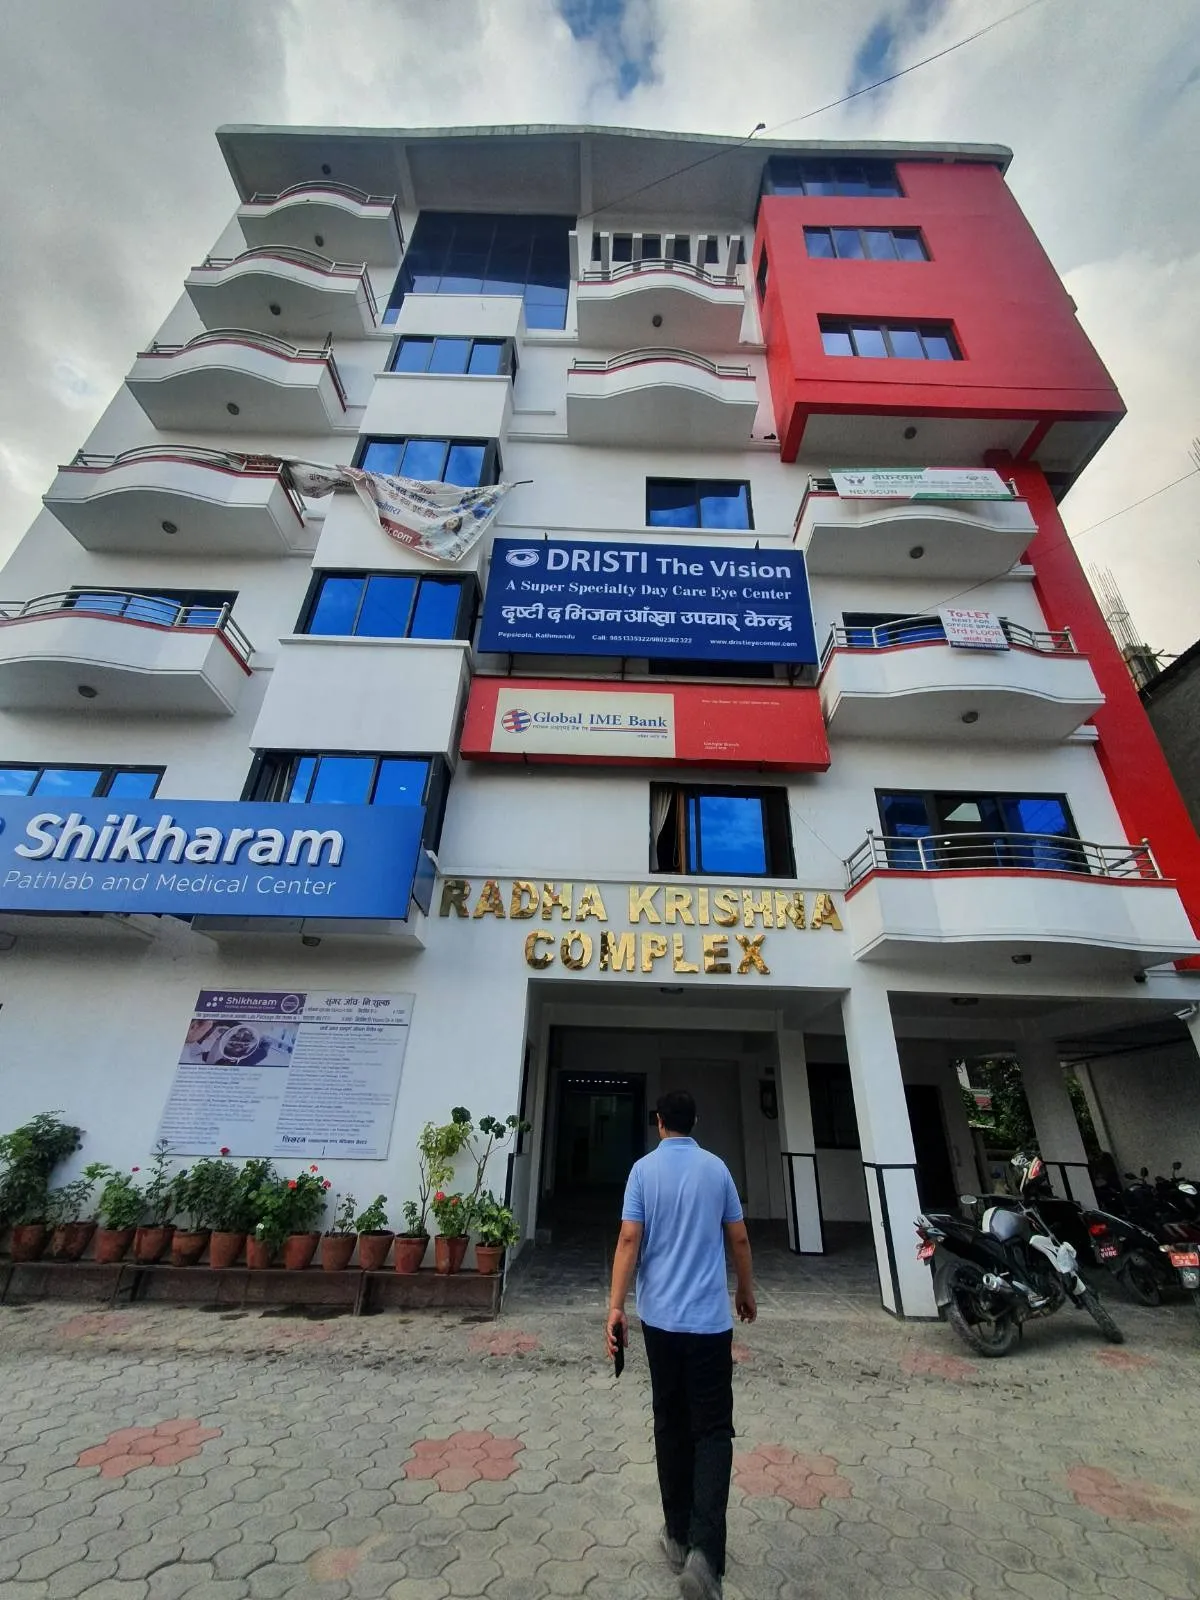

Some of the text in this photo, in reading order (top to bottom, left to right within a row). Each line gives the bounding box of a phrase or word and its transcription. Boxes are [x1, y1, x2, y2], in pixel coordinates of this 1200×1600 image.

[546, 549, 791, 579] DRISTI The Vision
[505, 579, 792, 600] A Super Specialty Day Care Eye Center
[547, 607, 563, 623] द
[533, 711, 667, 727] Global IME Bank
[13, 812, 345, 865] Shikharam
[2, 870, 337, 896] Pathlab and Medical Center
[439, 879, 843, 931] RADHA KRISHNA
[524, 929, 771, 975] COMPLEX
[225, 996, 277, 1006] Shikharam
